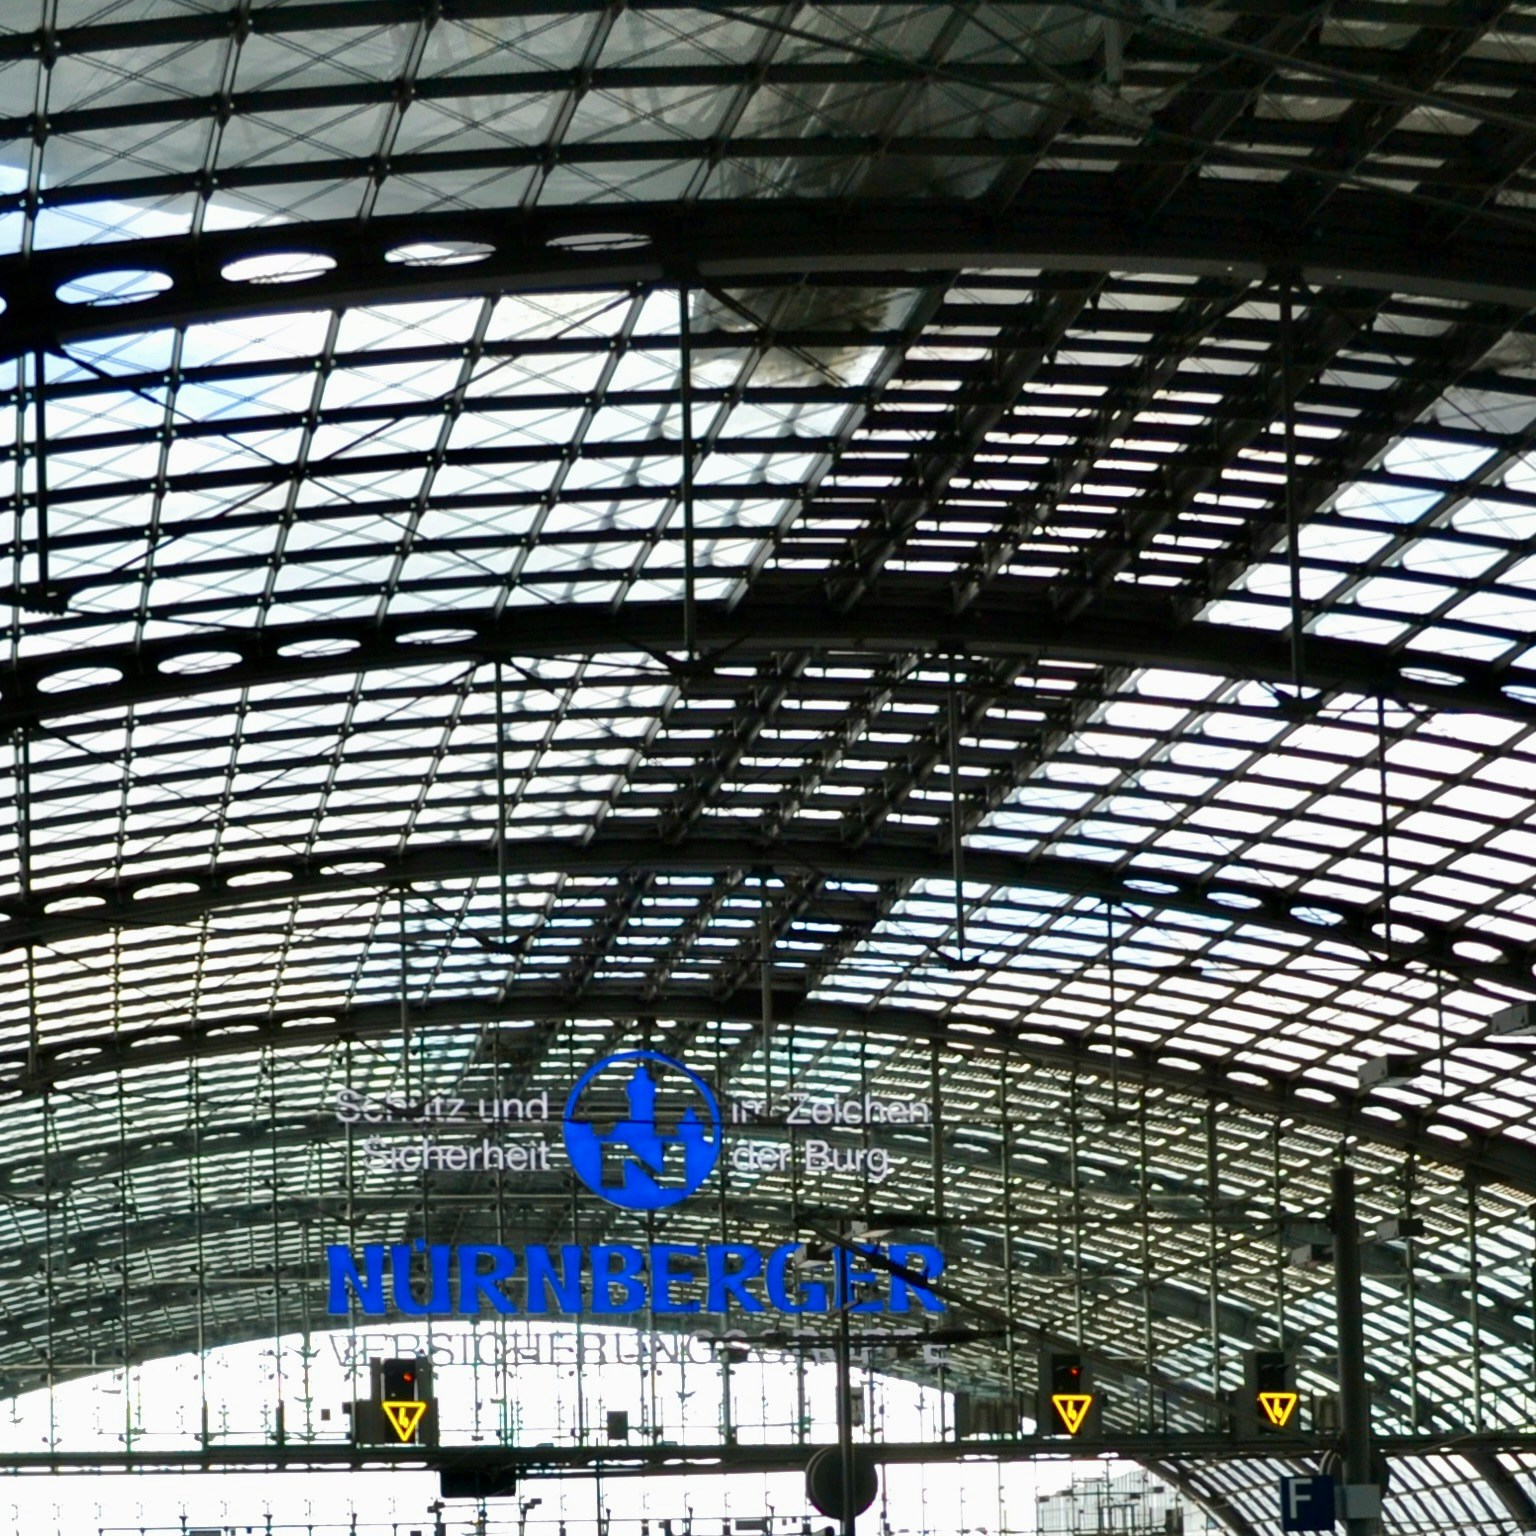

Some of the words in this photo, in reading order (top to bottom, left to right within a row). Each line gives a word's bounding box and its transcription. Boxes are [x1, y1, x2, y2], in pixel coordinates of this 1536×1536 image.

[478, 1091, 548, 1122] und
[786, 1094, 929, 1124] Zeichen
[364, 1137, 550, 1171] Sicherheit
[732, 1140, 789, 1171] der
[805, 1140, 889, 1180] Burg
[327, 1238, 946, 1315] NÜRNBERGER
[1289, 1478, 1313, 1519] F
